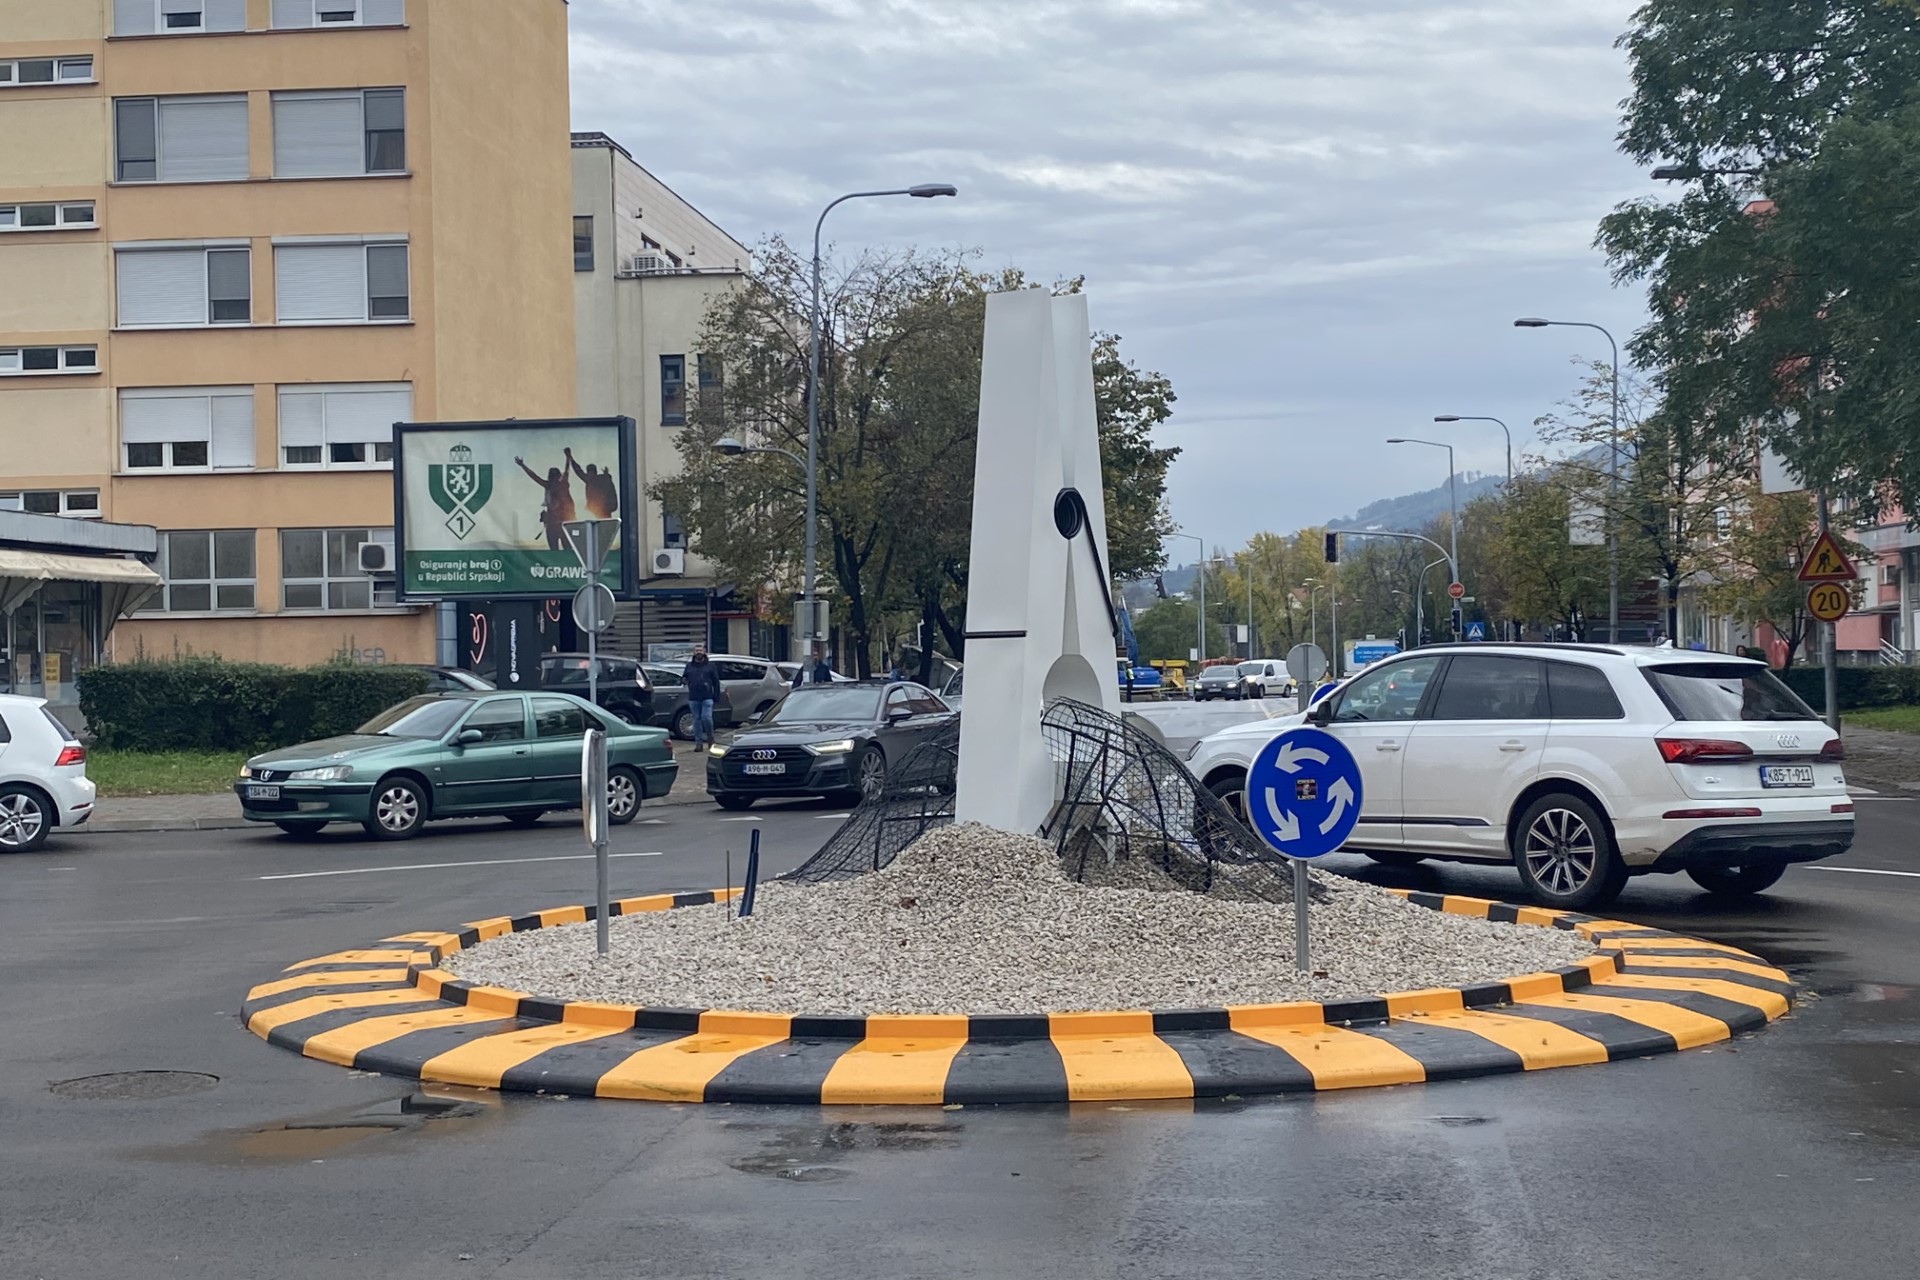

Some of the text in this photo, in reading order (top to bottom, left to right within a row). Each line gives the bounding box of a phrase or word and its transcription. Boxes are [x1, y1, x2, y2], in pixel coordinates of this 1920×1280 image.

[456, 516, 464, 532] 1
[420, 560, 467, 571] Osiguranje
[469, 559, 489, 571] broj
[417, 571, 505, 583] u Republici Srpskoj!
[1816, 591, 1841, 612] 20
[1767, 768, 1812, 782] K85-T-911
